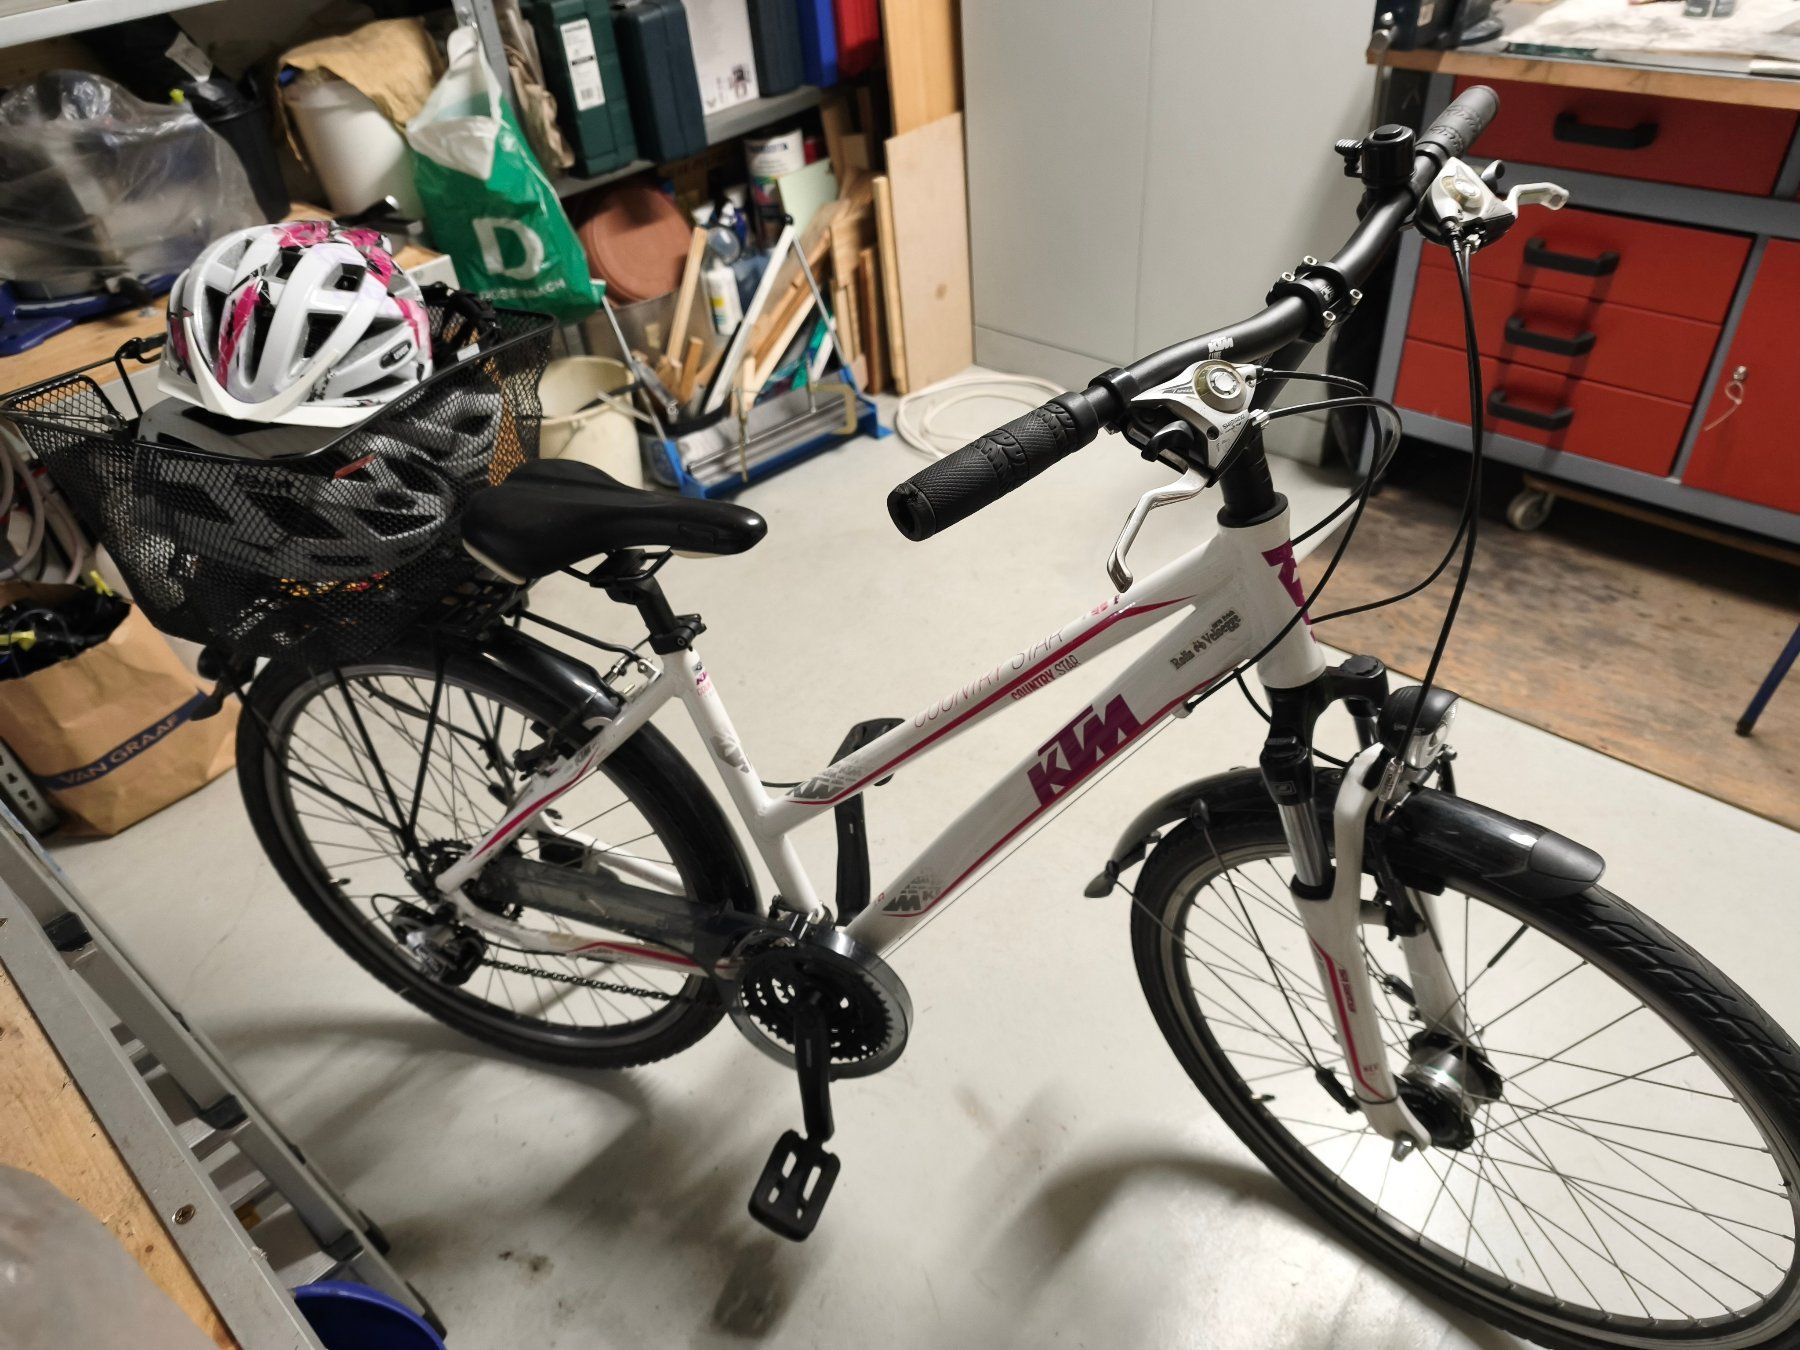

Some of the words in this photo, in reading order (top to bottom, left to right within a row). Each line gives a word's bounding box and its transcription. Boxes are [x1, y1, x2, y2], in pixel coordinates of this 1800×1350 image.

[472, 217, 545, 280] D
[1011, 669, 1056, 700] COUNTRY
[1055, 654, 1081, 675] STAR
[60, 762, 108, 784] VAN
[110, 714, 178, 764] GRAAF
[1027, 693, 1142, 806] KTM
